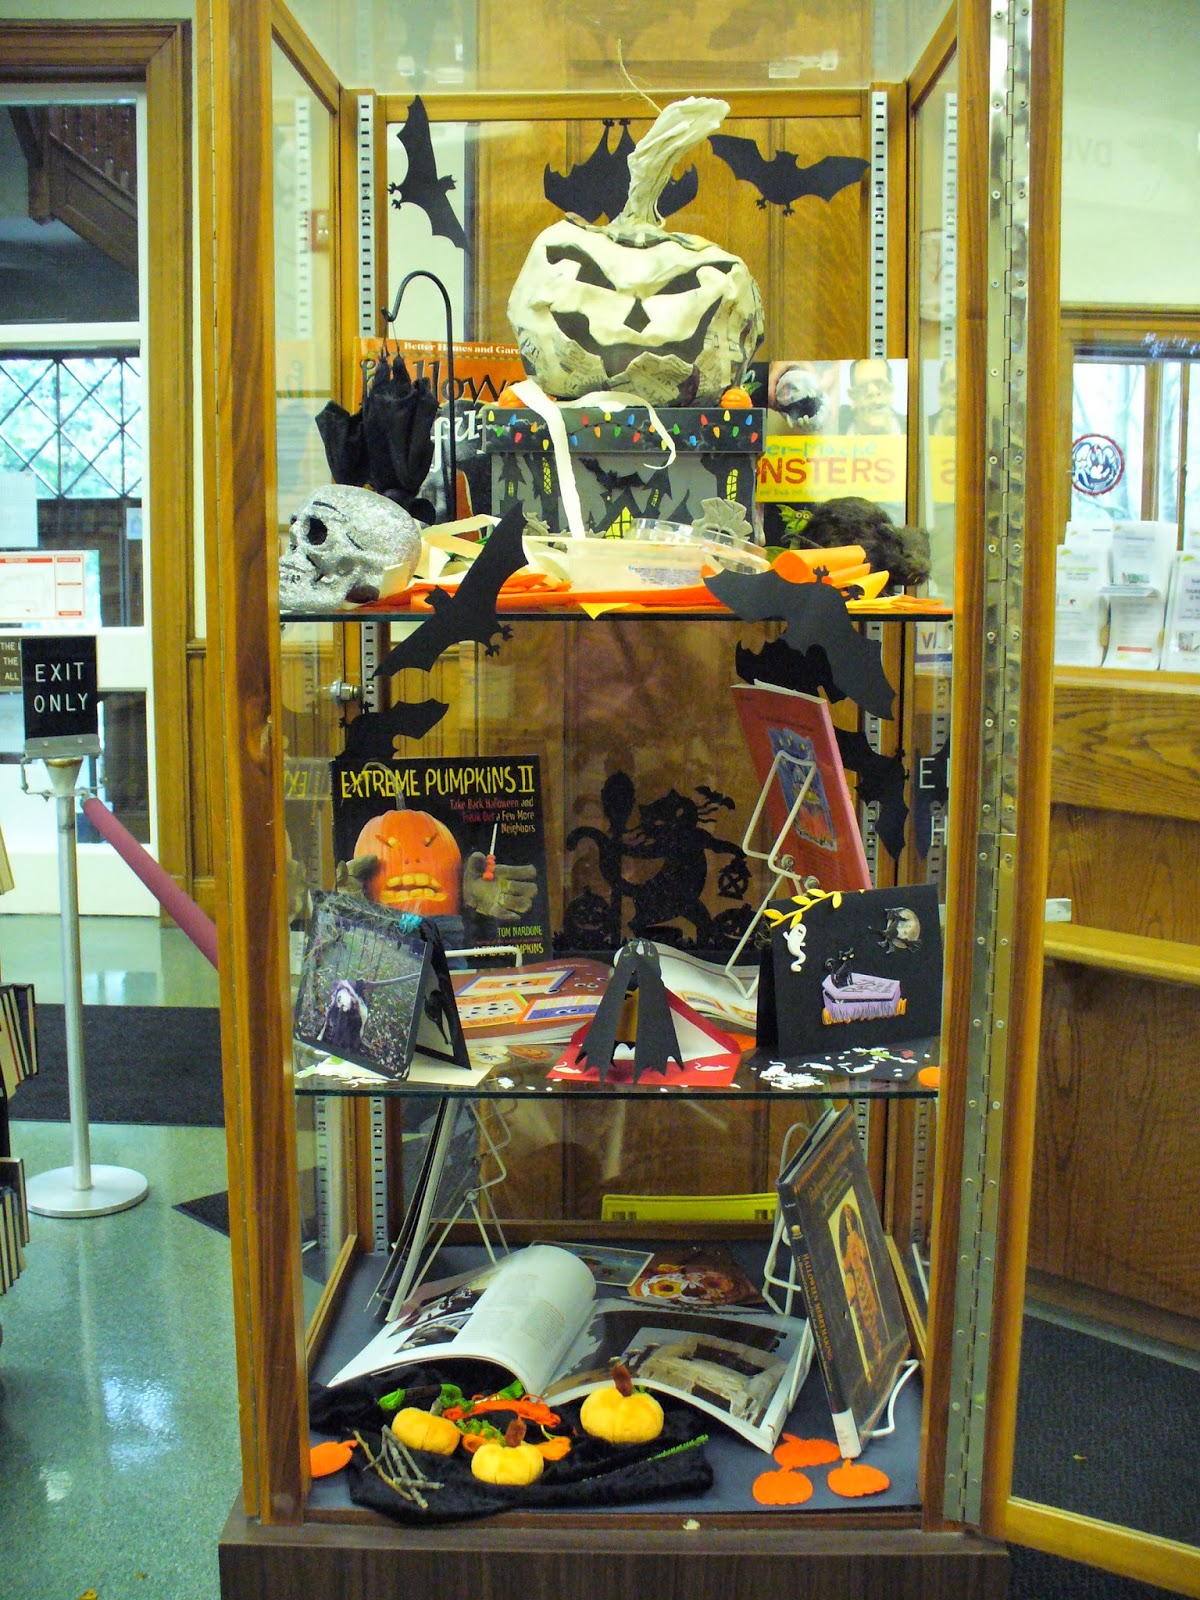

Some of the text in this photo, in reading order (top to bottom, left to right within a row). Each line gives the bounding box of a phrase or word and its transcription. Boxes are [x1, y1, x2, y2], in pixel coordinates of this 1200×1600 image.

[404, 342, 434, 352] Better
[438, 344, 472, 354] Hmes
[474, 346, 494, 354] and
[756, 457, 896, 485] NSTERS
[3, 656, 18, 666] THE
[4, 672, 19, 680] ALL
[35, 662, 84, 683] EXIT
[34, 692, 88, 713] ONLY
[340, 769, 420, 799] EXTREME
[518, 765, 536, 792] II
[450, 796, 534, 810] Take Back Halloween and
[496, 813, 500, 822] a
[502, 811, 516, 822] Few
[517, 810, 534, 820] More
[502, 822, 536, 836] Neighbors
[498, 926, 542, 938] TOM NARDONE
[507, 943, 544, 956] MPKINS
[802, 1254, 820, 1305] HALLOWEEN
[814, 1304, 834, 1361] MERRYMAKING
